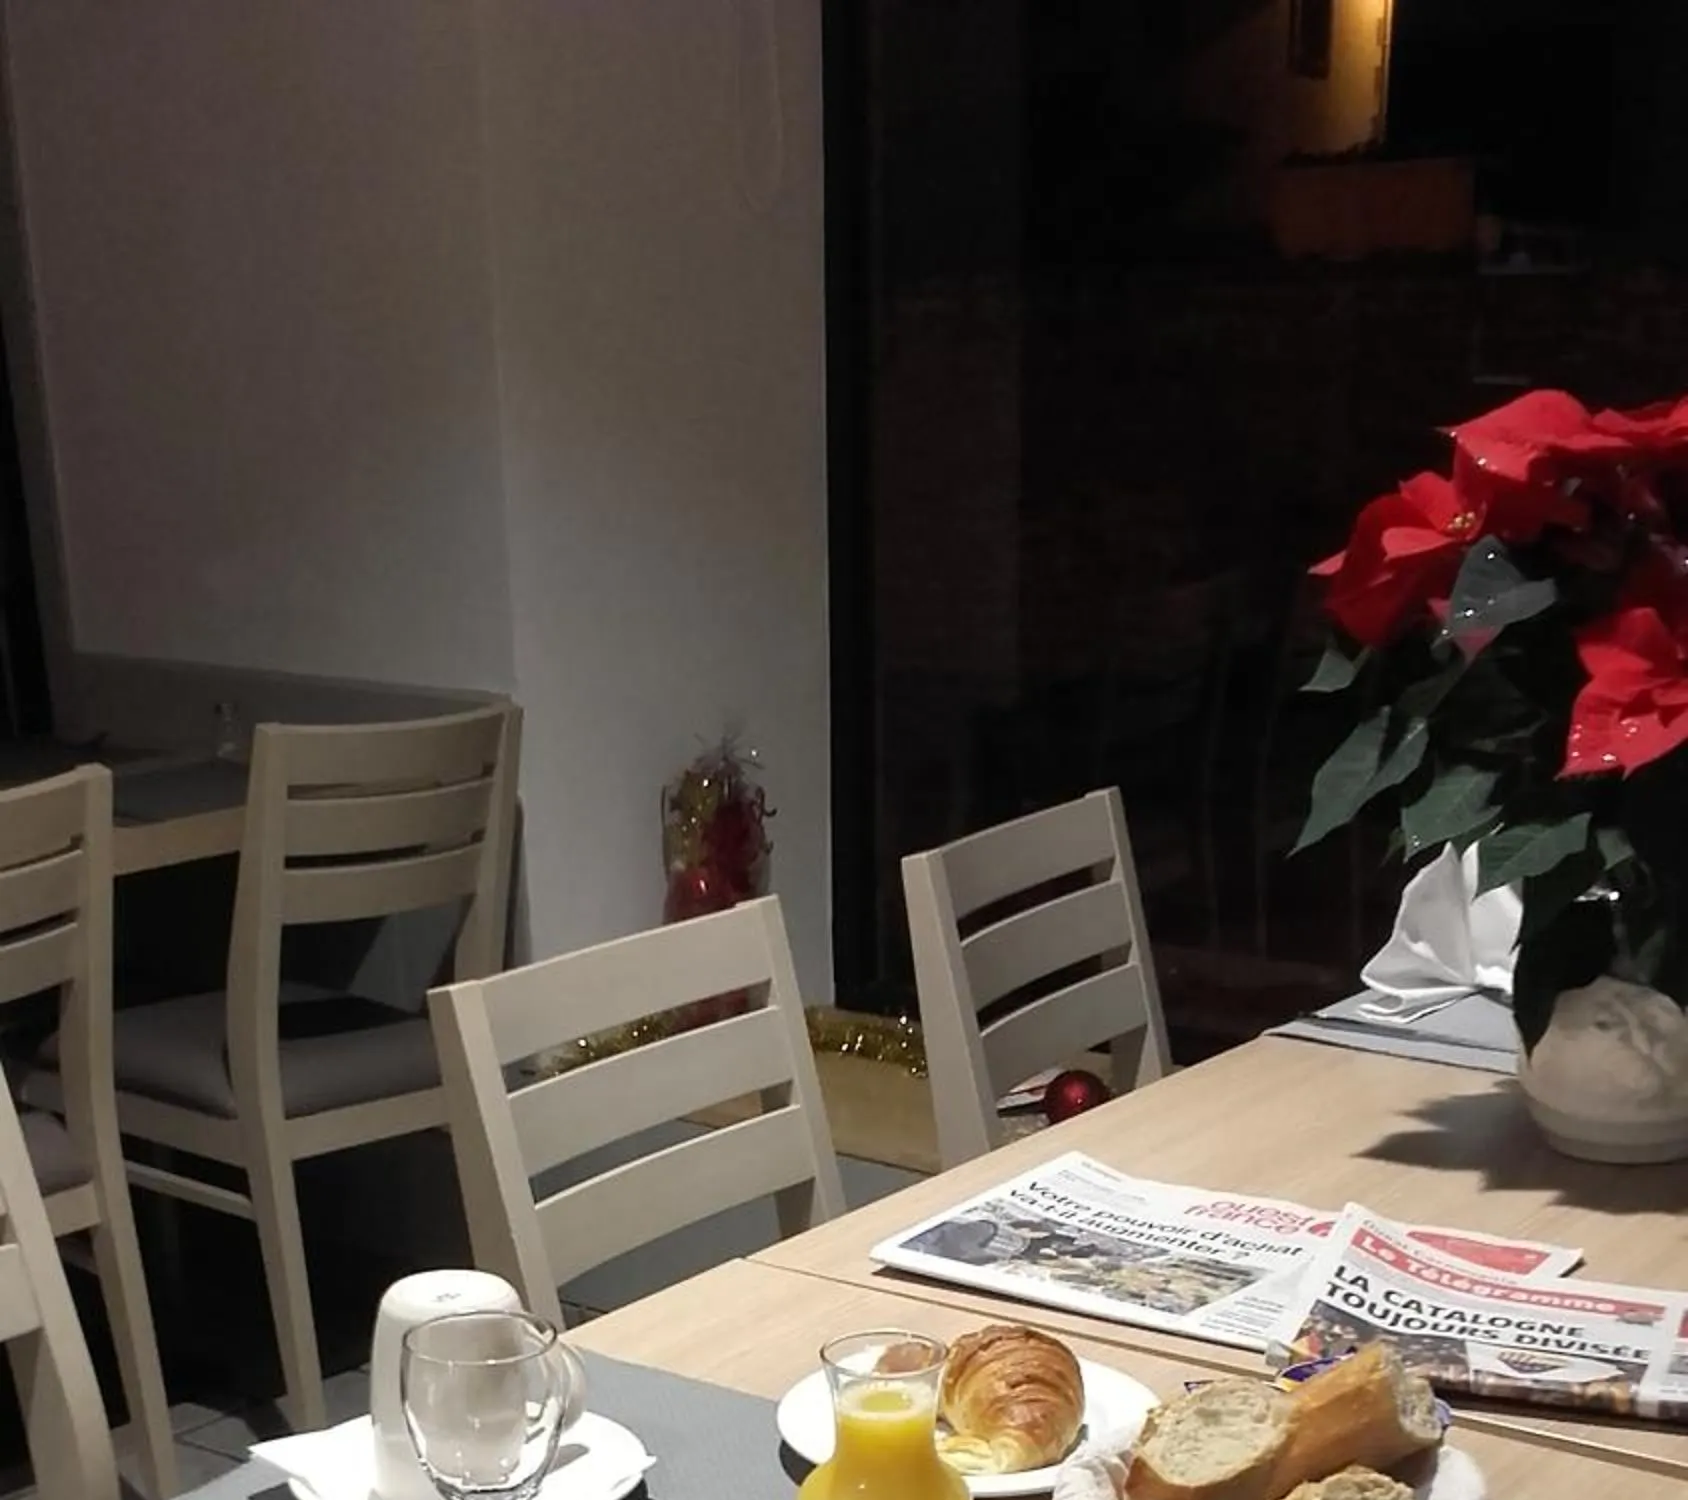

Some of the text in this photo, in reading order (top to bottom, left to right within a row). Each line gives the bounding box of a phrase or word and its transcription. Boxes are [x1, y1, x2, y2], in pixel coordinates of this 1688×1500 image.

[1029, 1181, 1092, 1211] Votre
[1091, 1210, 1198, 1236] pouvoir
[1199, 1231, 1303, 1256] d'achat
[1077, 1217, 1227, 1255] augmenter
[1325, 1281, 1500, 1340] TOUJOURS
[1333, 1264, 1586, 1338] LA CATALOGNE
[1360, 1235, 1397, 1262] Le
[1405, 1261, 1618, 1313] Télégramme
